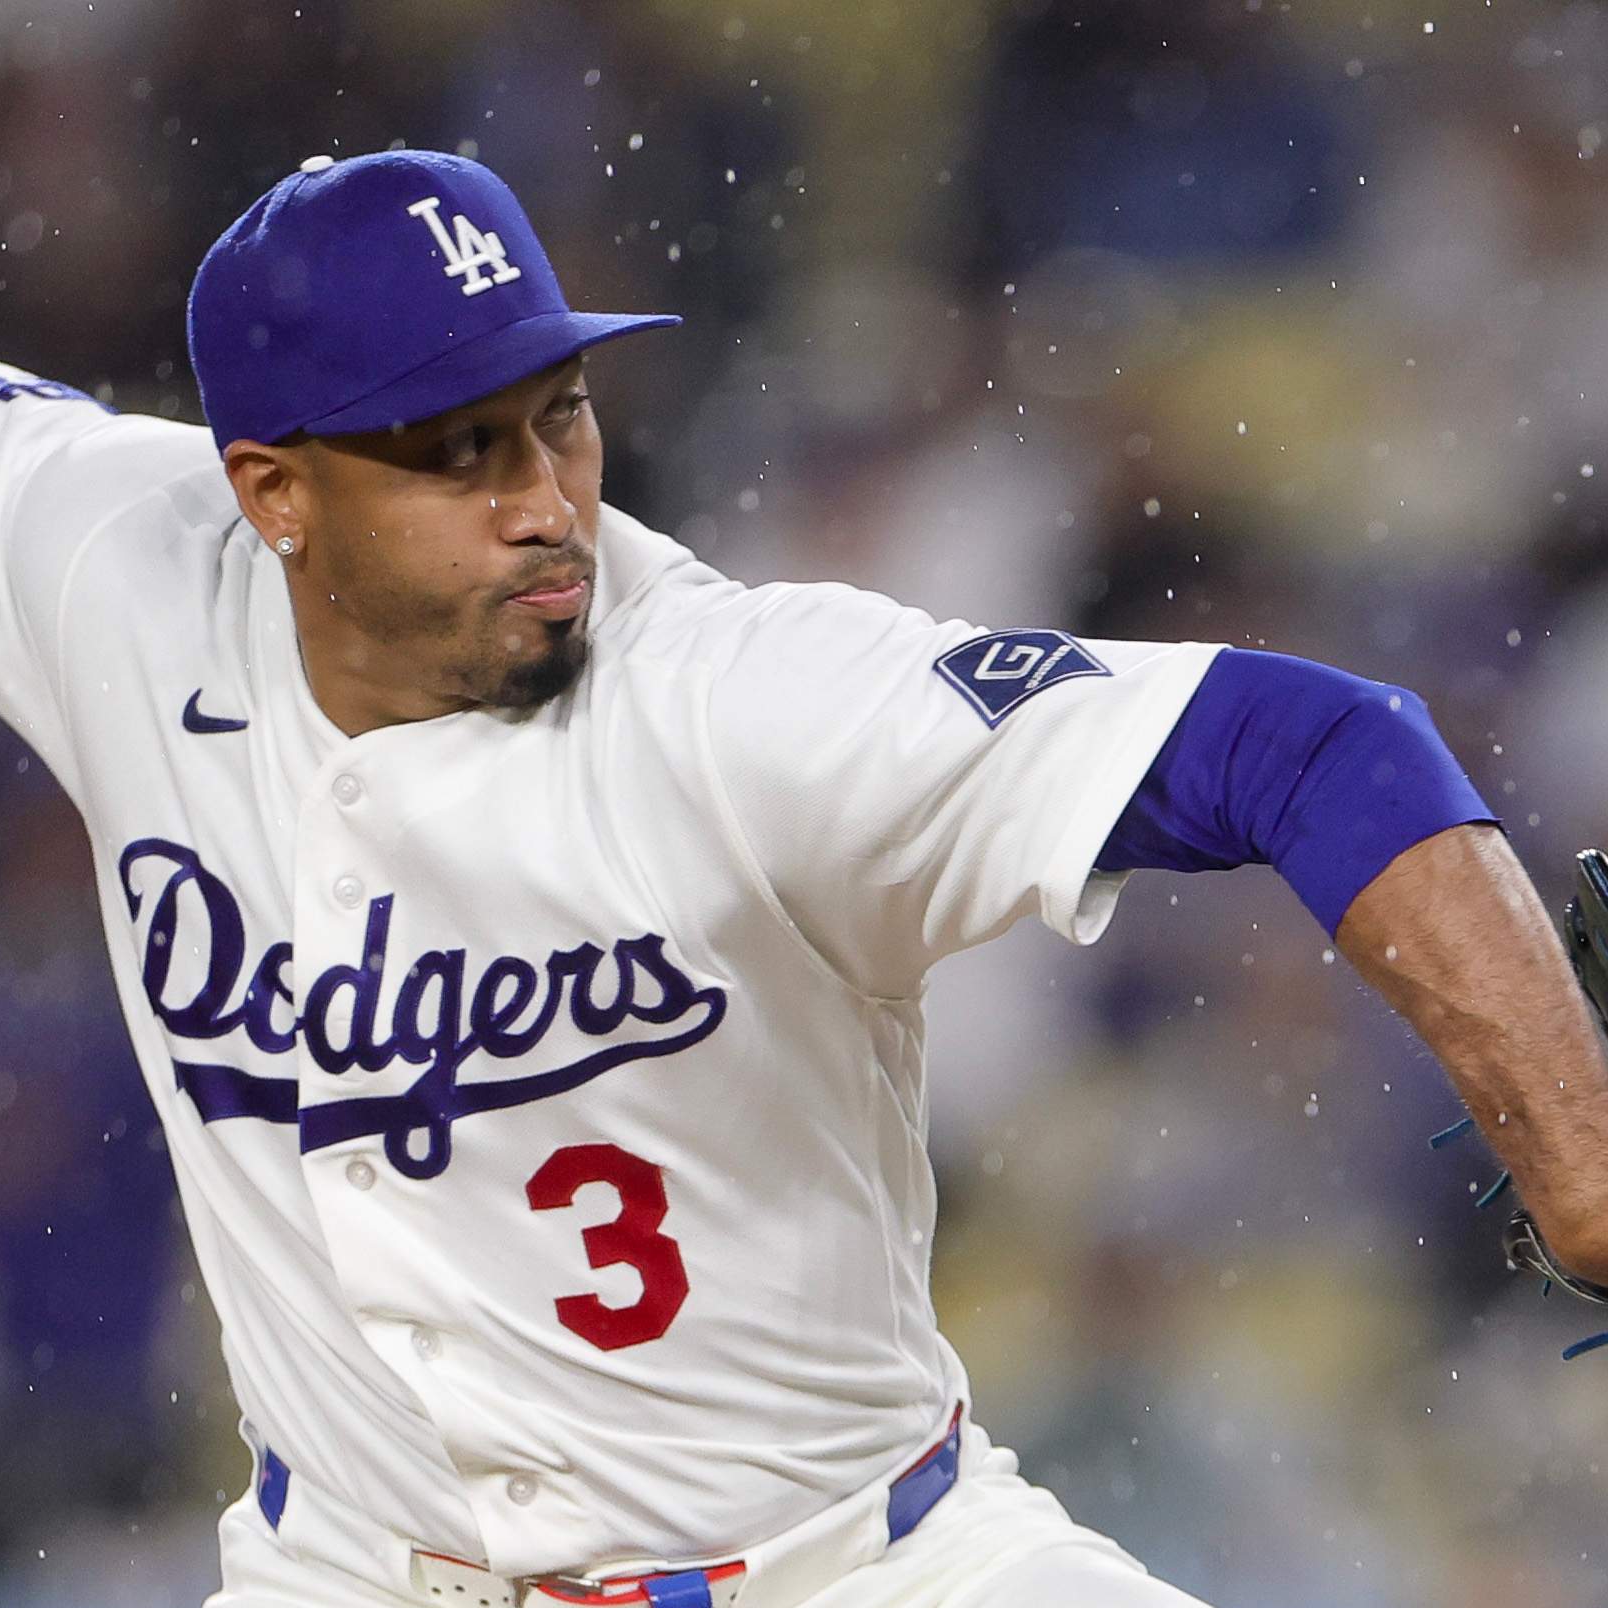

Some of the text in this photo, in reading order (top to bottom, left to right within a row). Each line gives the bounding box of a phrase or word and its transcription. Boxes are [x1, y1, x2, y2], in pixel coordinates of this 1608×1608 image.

[407, 196, 522, 297] LA
[973, 641, 1046, 681] G
[118, 836, 727, 1180] Dodgers
[525, 1143, 690, 1352] 3
